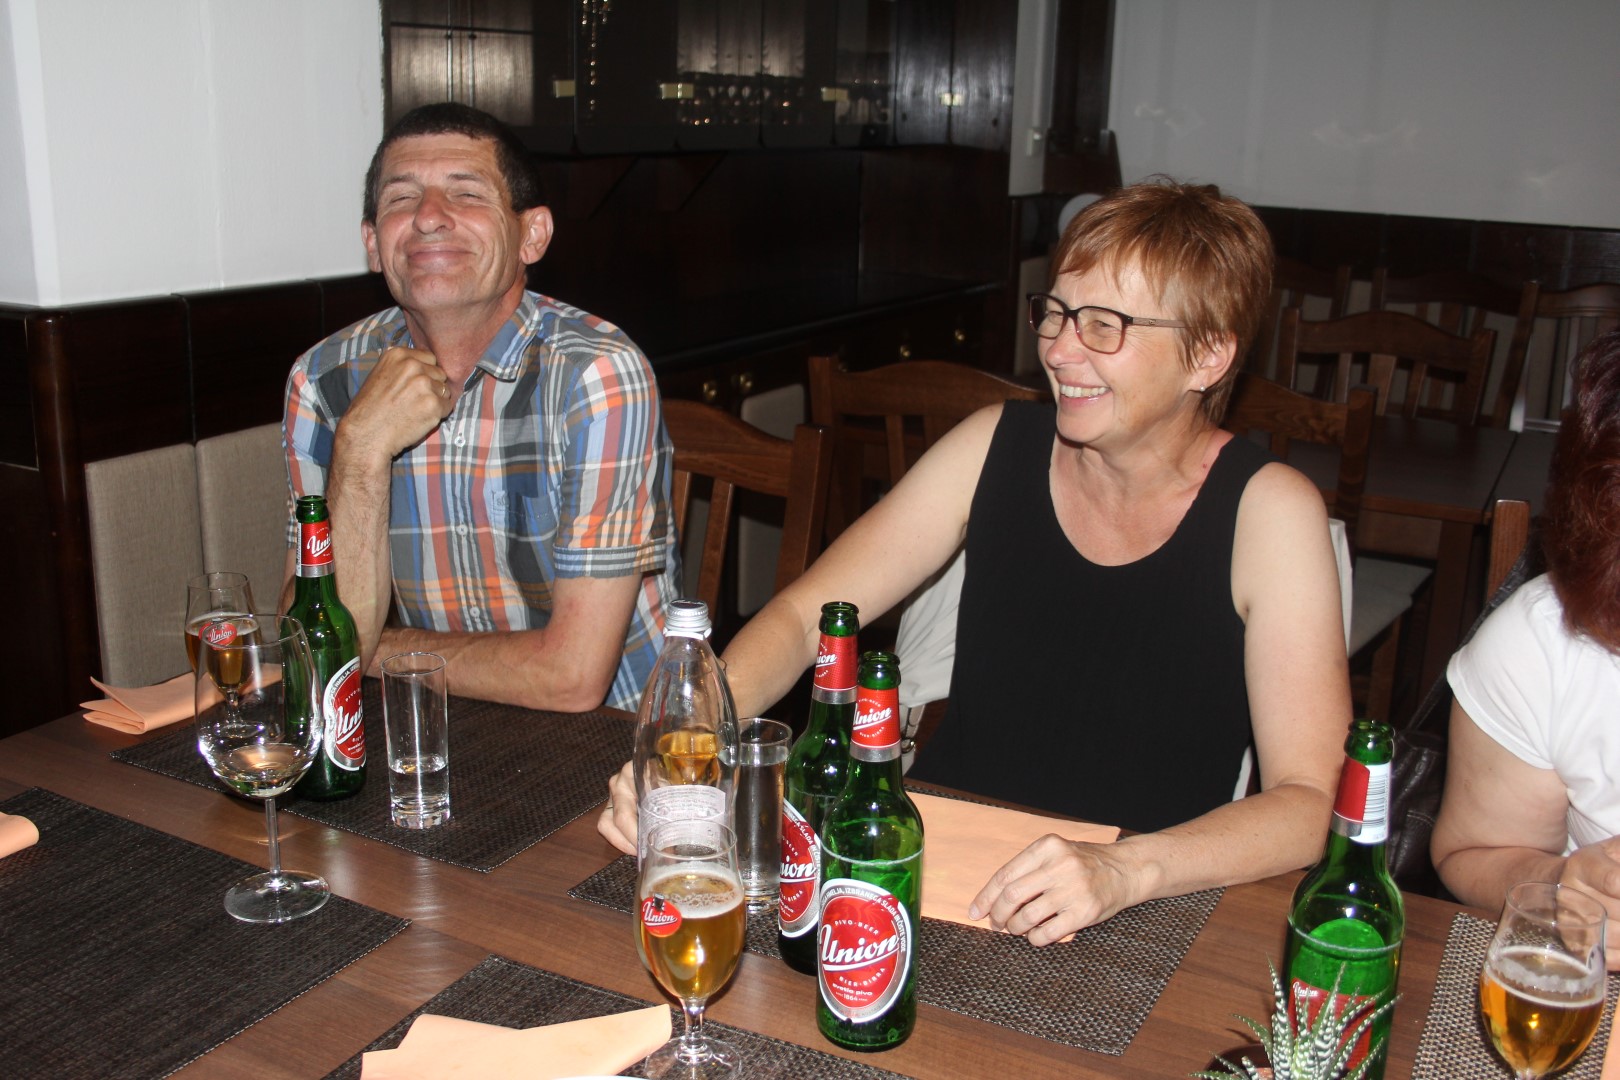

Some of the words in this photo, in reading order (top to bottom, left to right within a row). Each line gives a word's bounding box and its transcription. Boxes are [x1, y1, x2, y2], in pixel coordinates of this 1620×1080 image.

[306, 532, 331, 554] Uni
[336, 699, 363, 739] Uni
[642, 901, 678, 923] Union
[881, 899, 897, 917] SLADA
[820, 924, 899, 963] Union
[855, 989, 873, 997] pivo
